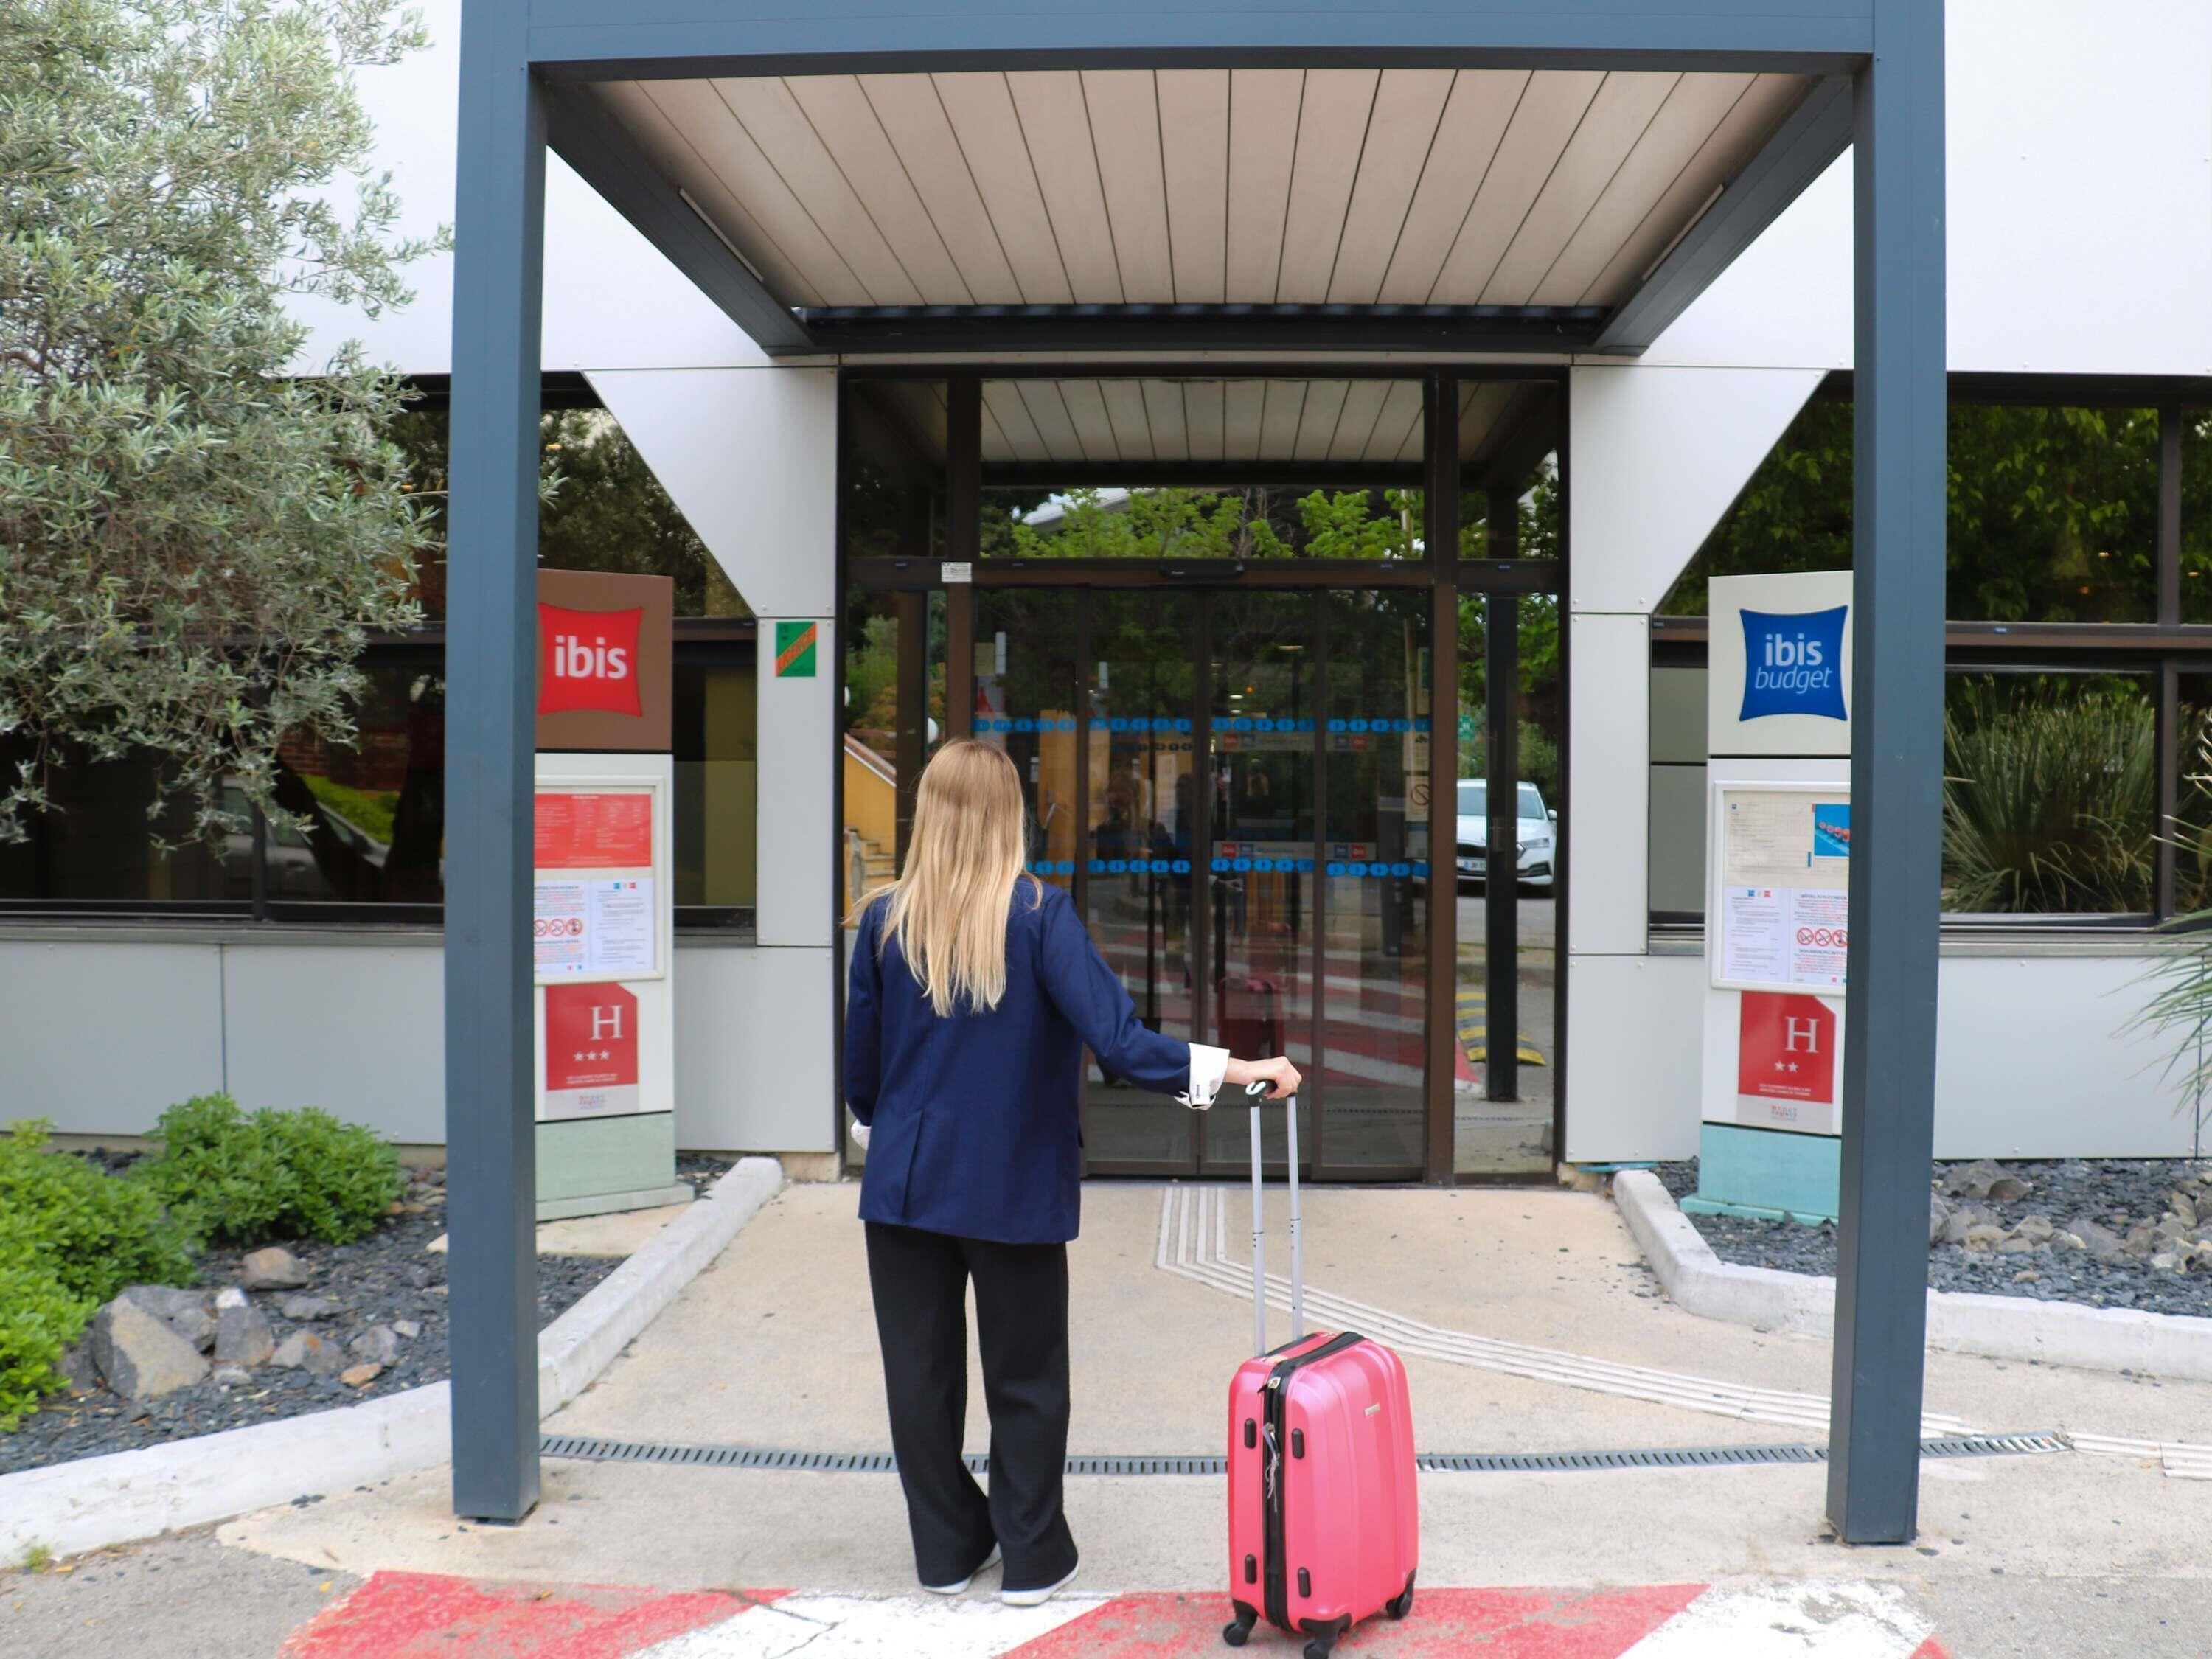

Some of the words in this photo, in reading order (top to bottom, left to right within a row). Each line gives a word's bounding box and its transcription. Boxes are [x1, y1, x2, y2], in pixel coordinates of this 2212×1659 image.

[554, 635, 628, 680] ibis
[1765, 633, 1823, 667] ibis
[1755, 666, 1833, 695] budget
[590, 1004, 624, 1041] H
[1784, 1015, 1820, 1054] H
